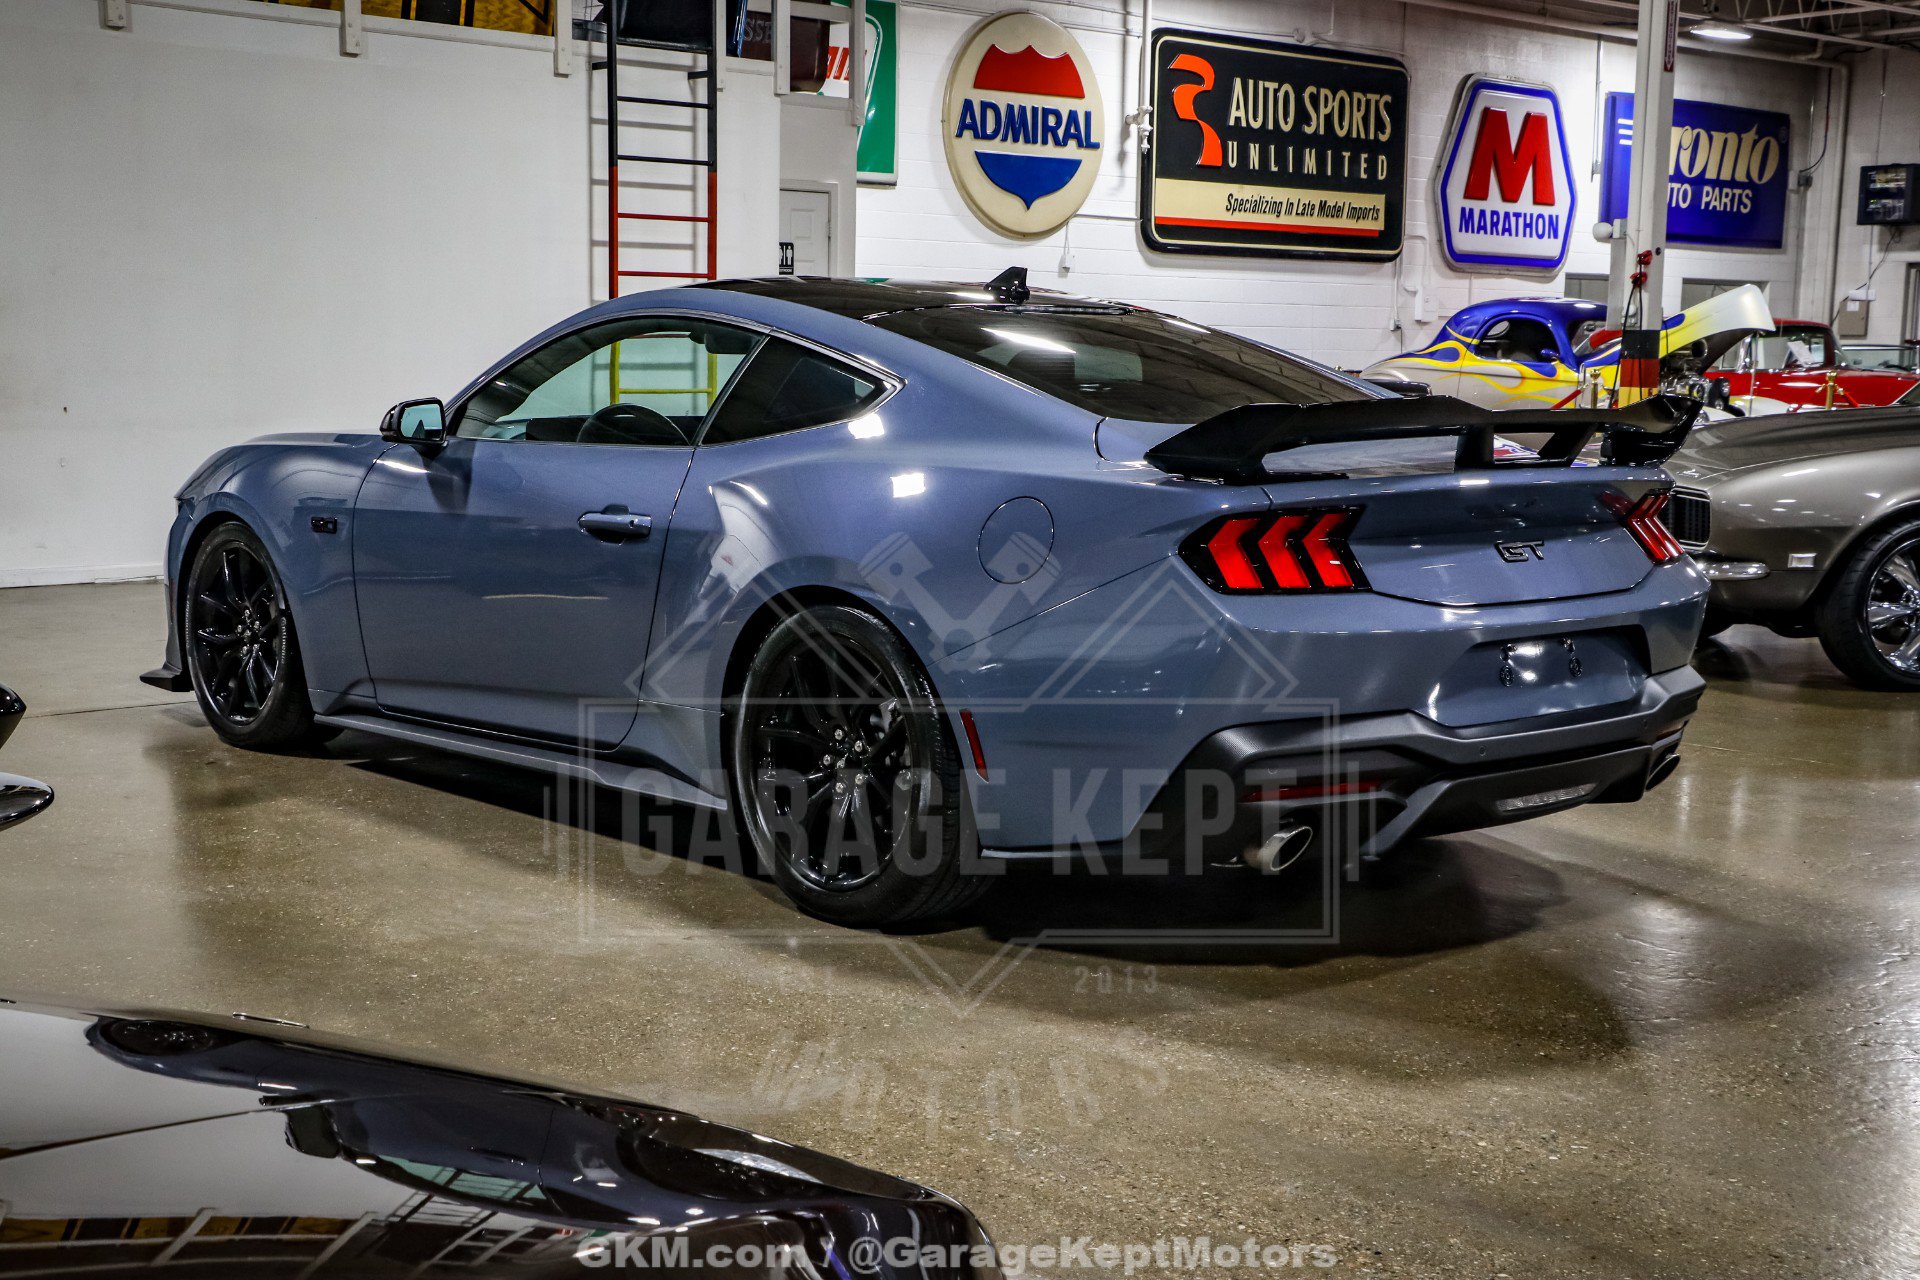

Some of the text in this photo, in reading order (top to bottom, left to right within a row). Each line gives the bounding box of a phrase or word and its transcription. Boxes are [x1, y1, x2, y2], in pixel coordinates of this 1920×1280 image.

[955, 98, 1101, 149] ADMIRAL
[1228, 77, 1392, 142] AUTO SPORTS
[1227, 140, 1388, 181] UNLIMITED
[1463, 107, 1555, 206] M
[1668, 123, 1780, 185] ronto
[1225, 193, 1381, 223] Specializing In Late Model Imports
[1667, 182, 1752, 214] TO PARTS
[1459, 206, 1559, 240] MARATHON
[1494, 540, 1544, 563] GT
